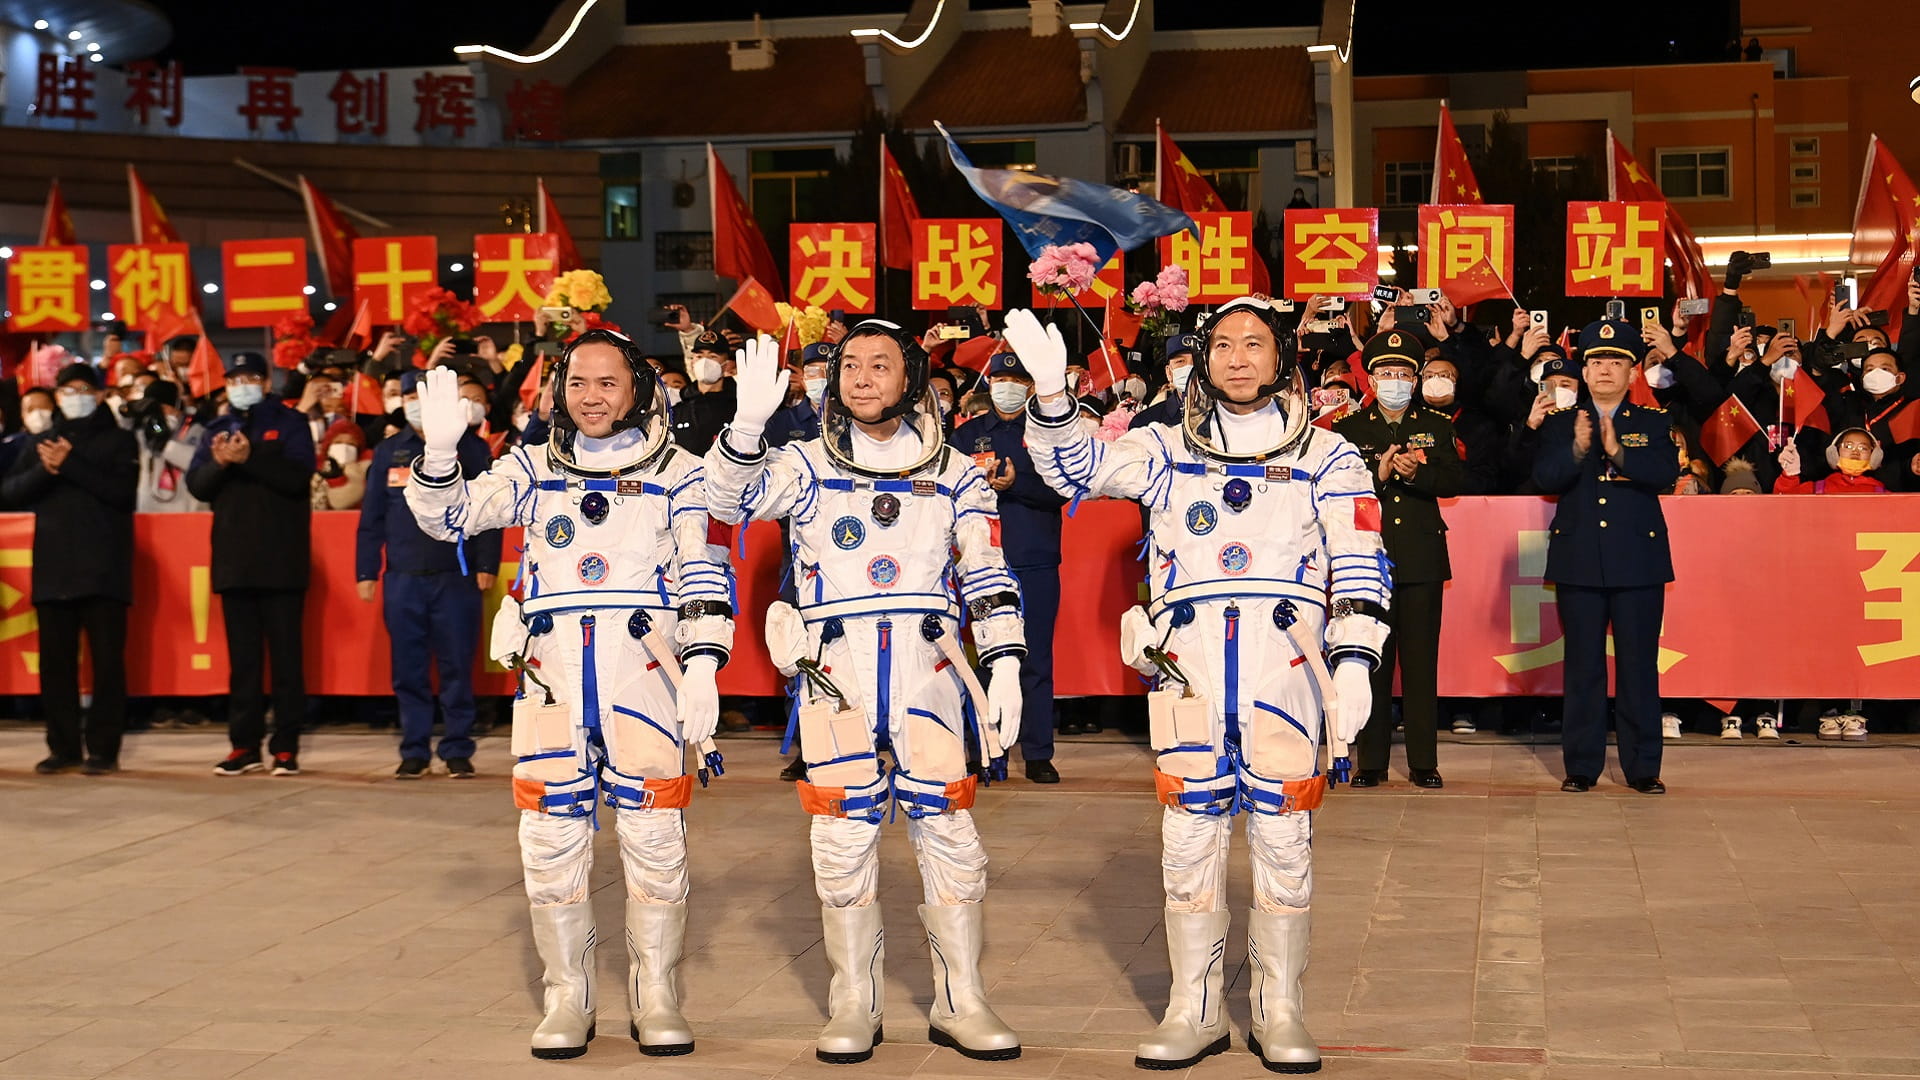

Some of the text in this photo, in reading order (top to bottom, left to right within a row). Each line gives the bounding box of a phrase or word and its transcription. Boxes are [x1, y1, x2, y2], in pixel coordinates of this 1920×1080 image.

[34, 53, 184, 127] 胜利
[10, 237, 555, 327] 贯彻二十大
